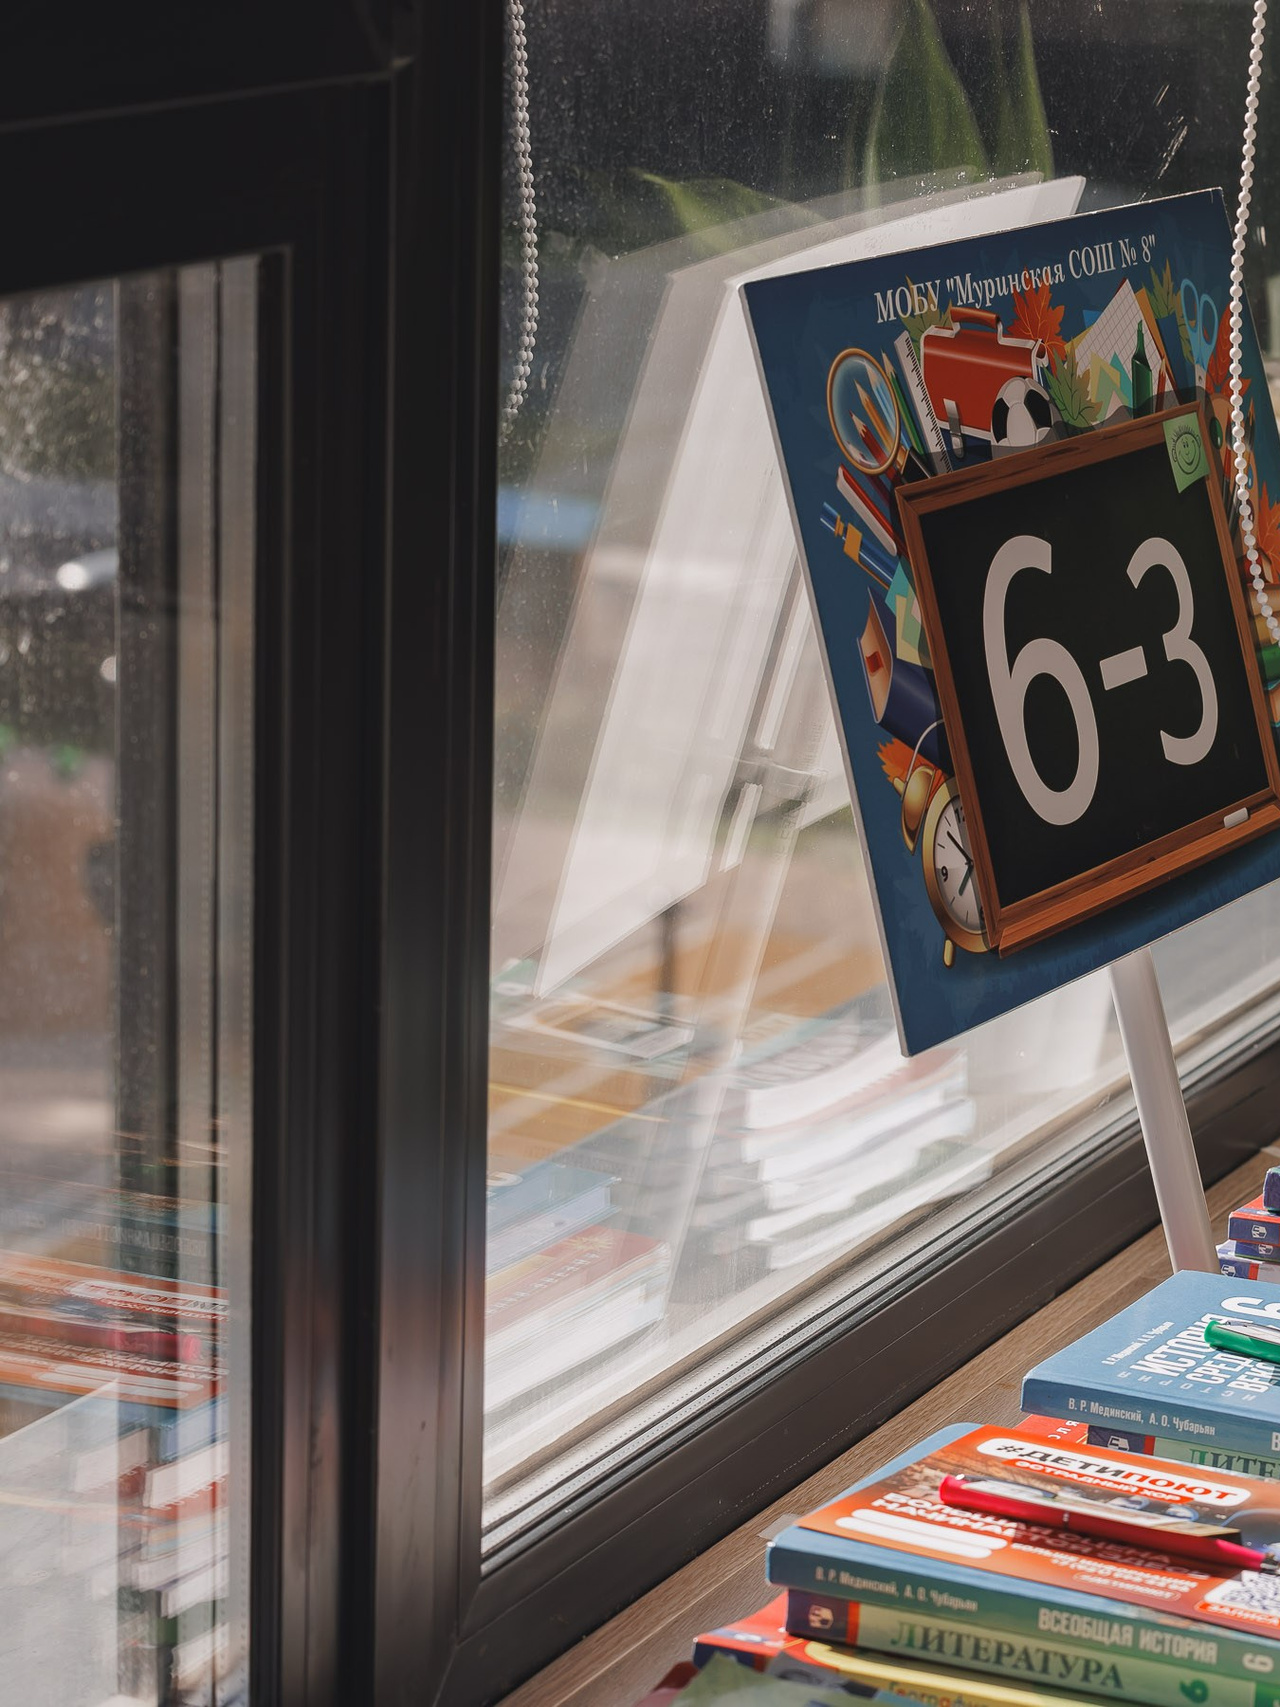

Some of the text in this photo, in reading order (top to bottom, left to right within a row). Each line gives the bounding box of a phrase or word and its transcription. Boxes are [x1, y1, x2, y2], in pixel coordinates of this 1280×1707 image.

[874, 234, 1156, 323] МОБУ "Муринская СОШ № 8"
[983, 535, 1218, 825] 6-3
[940, 866, 949, 882] 9
[1068, 1398, 1216, 1436] В. Р. Мединский, А. О. Чубарьян
[996, 1442, 1238, 1500] #ДЕТИПОЮТ
[891, 1621, 1124, 1690] ЛИТЕРАТУРА
[1038, 1607, 1133, 1647] ВСЕОБЩАЯ
[1138, 1630, 1218, 1665] ИСТОРИЯ
